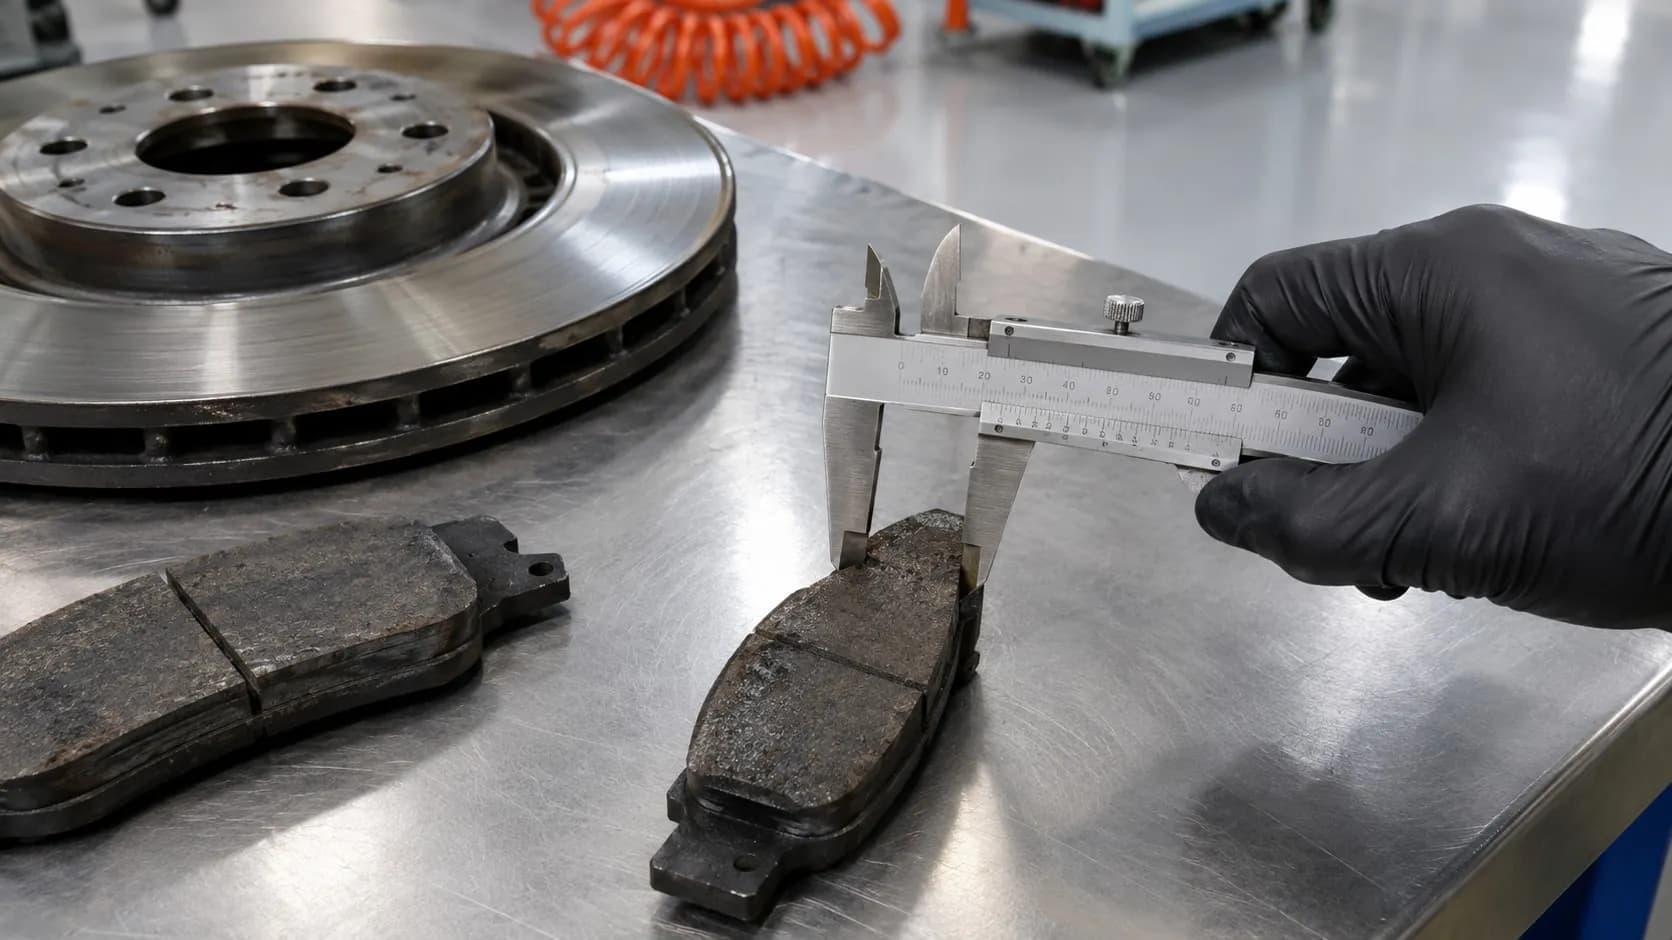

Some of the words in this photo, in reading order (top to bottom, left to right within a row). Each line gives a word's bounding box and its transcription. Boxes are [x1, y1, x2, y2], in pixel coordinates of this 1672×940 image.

[938, 366, 949, 376] 10
[978, 371, 991, 381] 20
[1020, 375, 1033, 385] 30
[1062, 380, 1076, 391] 40
